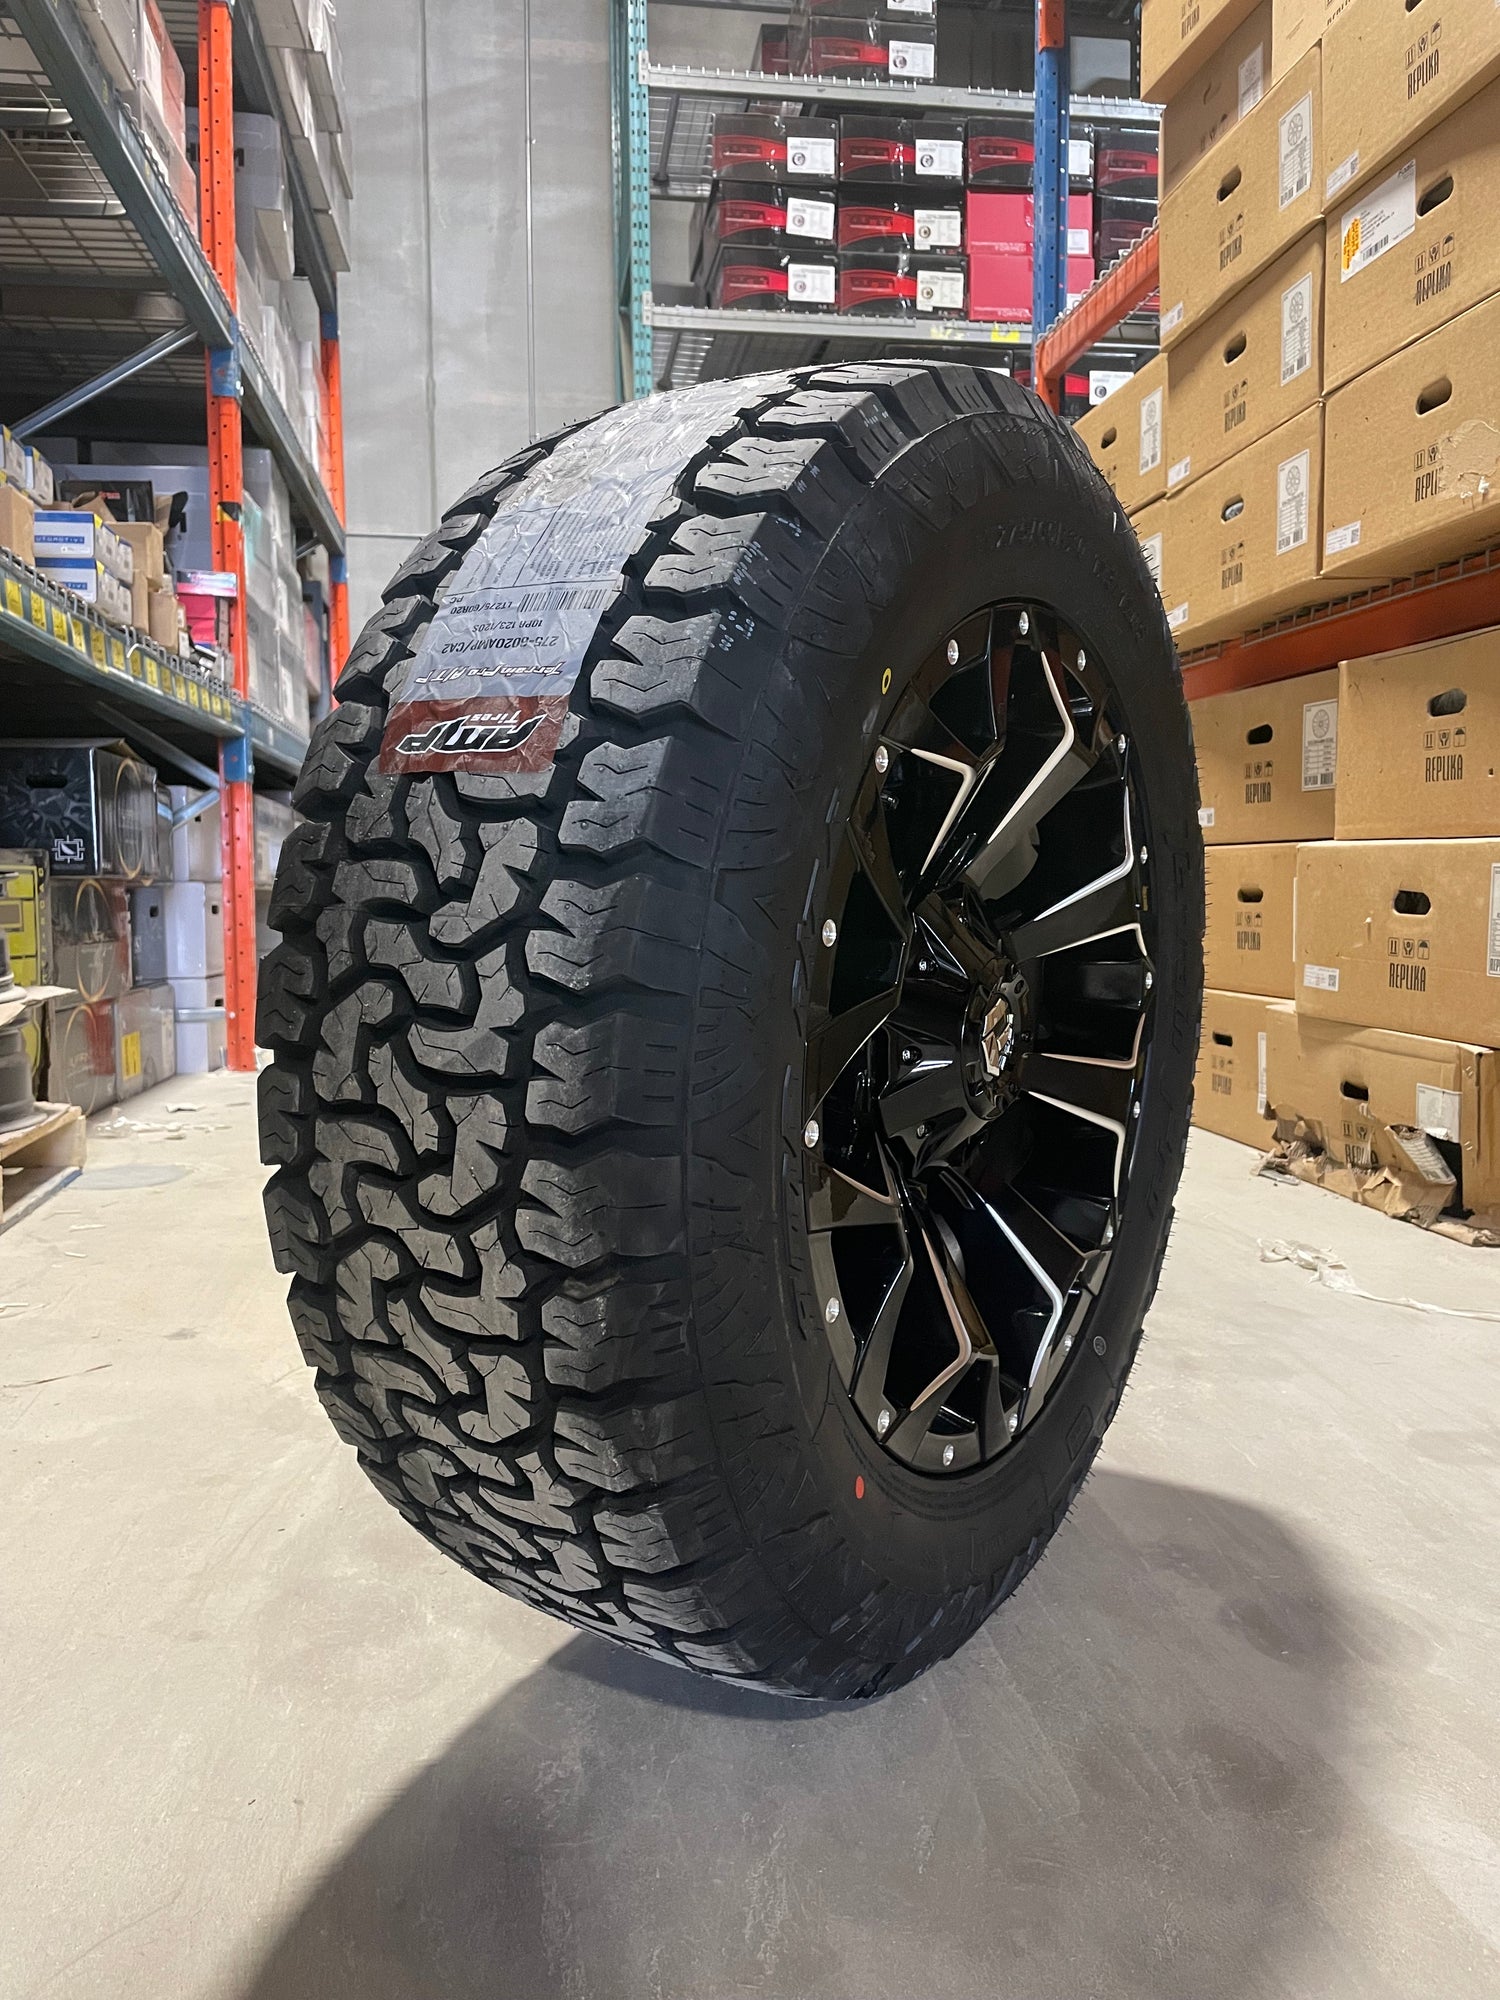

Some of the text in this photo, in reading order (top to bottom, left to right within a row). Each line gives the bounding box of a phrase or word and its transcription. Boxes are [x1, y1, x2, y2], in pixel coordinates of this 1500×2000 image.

[1407, 50, 1440, 101] REPLIKA
[1220, 233, 1242, 272] REPLIKA
[1416, 260, 1451, 306] REPLIKA
[1224, 400, 1246, 433] REPLIKA
[1415, 466, 1444, 503] REPLI
[1221, 562, 1243, 590] REPLIKA
[450, 595, 464, 604] PC
[450, 601, 512, 615] LT275/60R20
[472, 620, 516, 633] 123/120S
[442, 636, 559, 654] 275-6020AMP/CA2
[431, 664, 468, 683] A/T
[467, 663, 505, 677] Pro
[500, 661, 567, 677] Terrain
[470, 710, 521, 724] Tires
[395, 714, 548, 755] AMP
[1425, 754, 1463, 783] REPLIKA
[1245, 782, 1271, 804] REPLIKA
[1236, 931, 1261, 951] REPLIKA
[1389, 962, 1426, 992] REPLIKA
